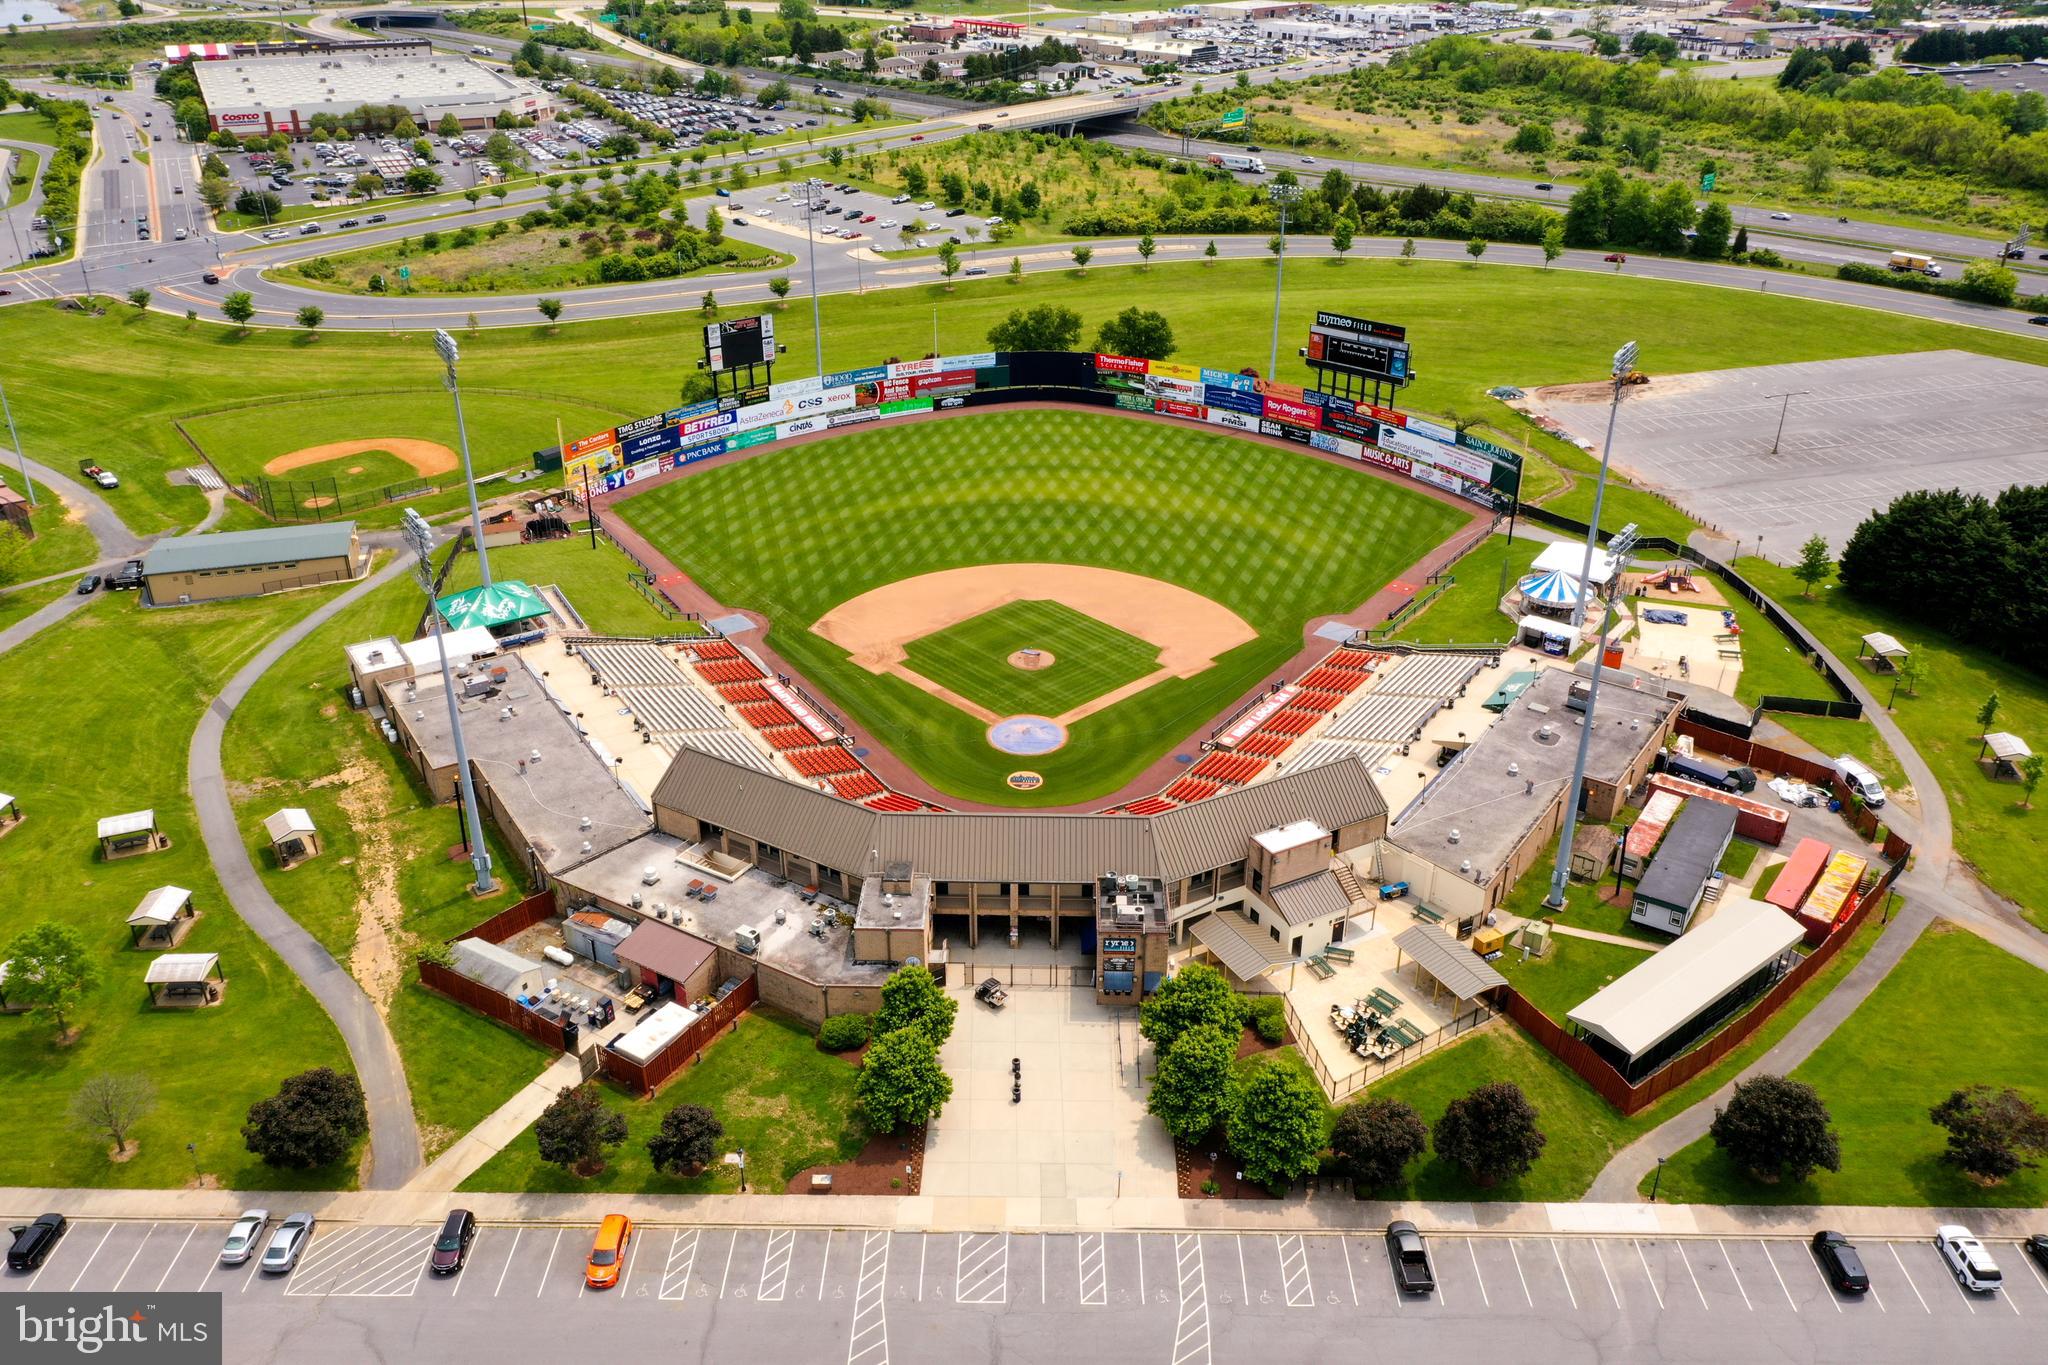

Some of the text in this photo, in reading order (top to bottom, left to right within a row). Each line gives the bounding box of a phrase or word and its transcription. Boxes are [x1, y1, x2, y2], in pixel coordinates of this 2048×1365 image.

[222, 113, 259, 121] COSTCO
[1319, 313, 1372, 332] nymeo FIELD
[896, 361, 922, 372] EYRE
[1099, 355, 1144, 367] ThermoFisher
[1100, 363, 1143, 372] SCIENTIFIC
[827, 393, 851, 403] xerox
[1267, 400, 1307, 416] Roy Rogers
[740, 409, 784, 424] AstraZeneca
[618, 423, 633, 434] TMG
[684, 413, 732, 434] BETFRED
[1261, 420, 1281, 431] SEAN
[687, 426, 730, 443] SPORTSBOOK
[1261, 427, 1283, 437] BRINK
[639, 434, 661, 446] Lonza
[1466, 436, 1488, 449] SAINT
[686, 444, 722, 460] PNC BANK
[1383, 436, 1412, 451] Educational
[1412, 445, 1433, 458] Systems
[1363, 446, 1410, 470] MUSIC & ARTS
